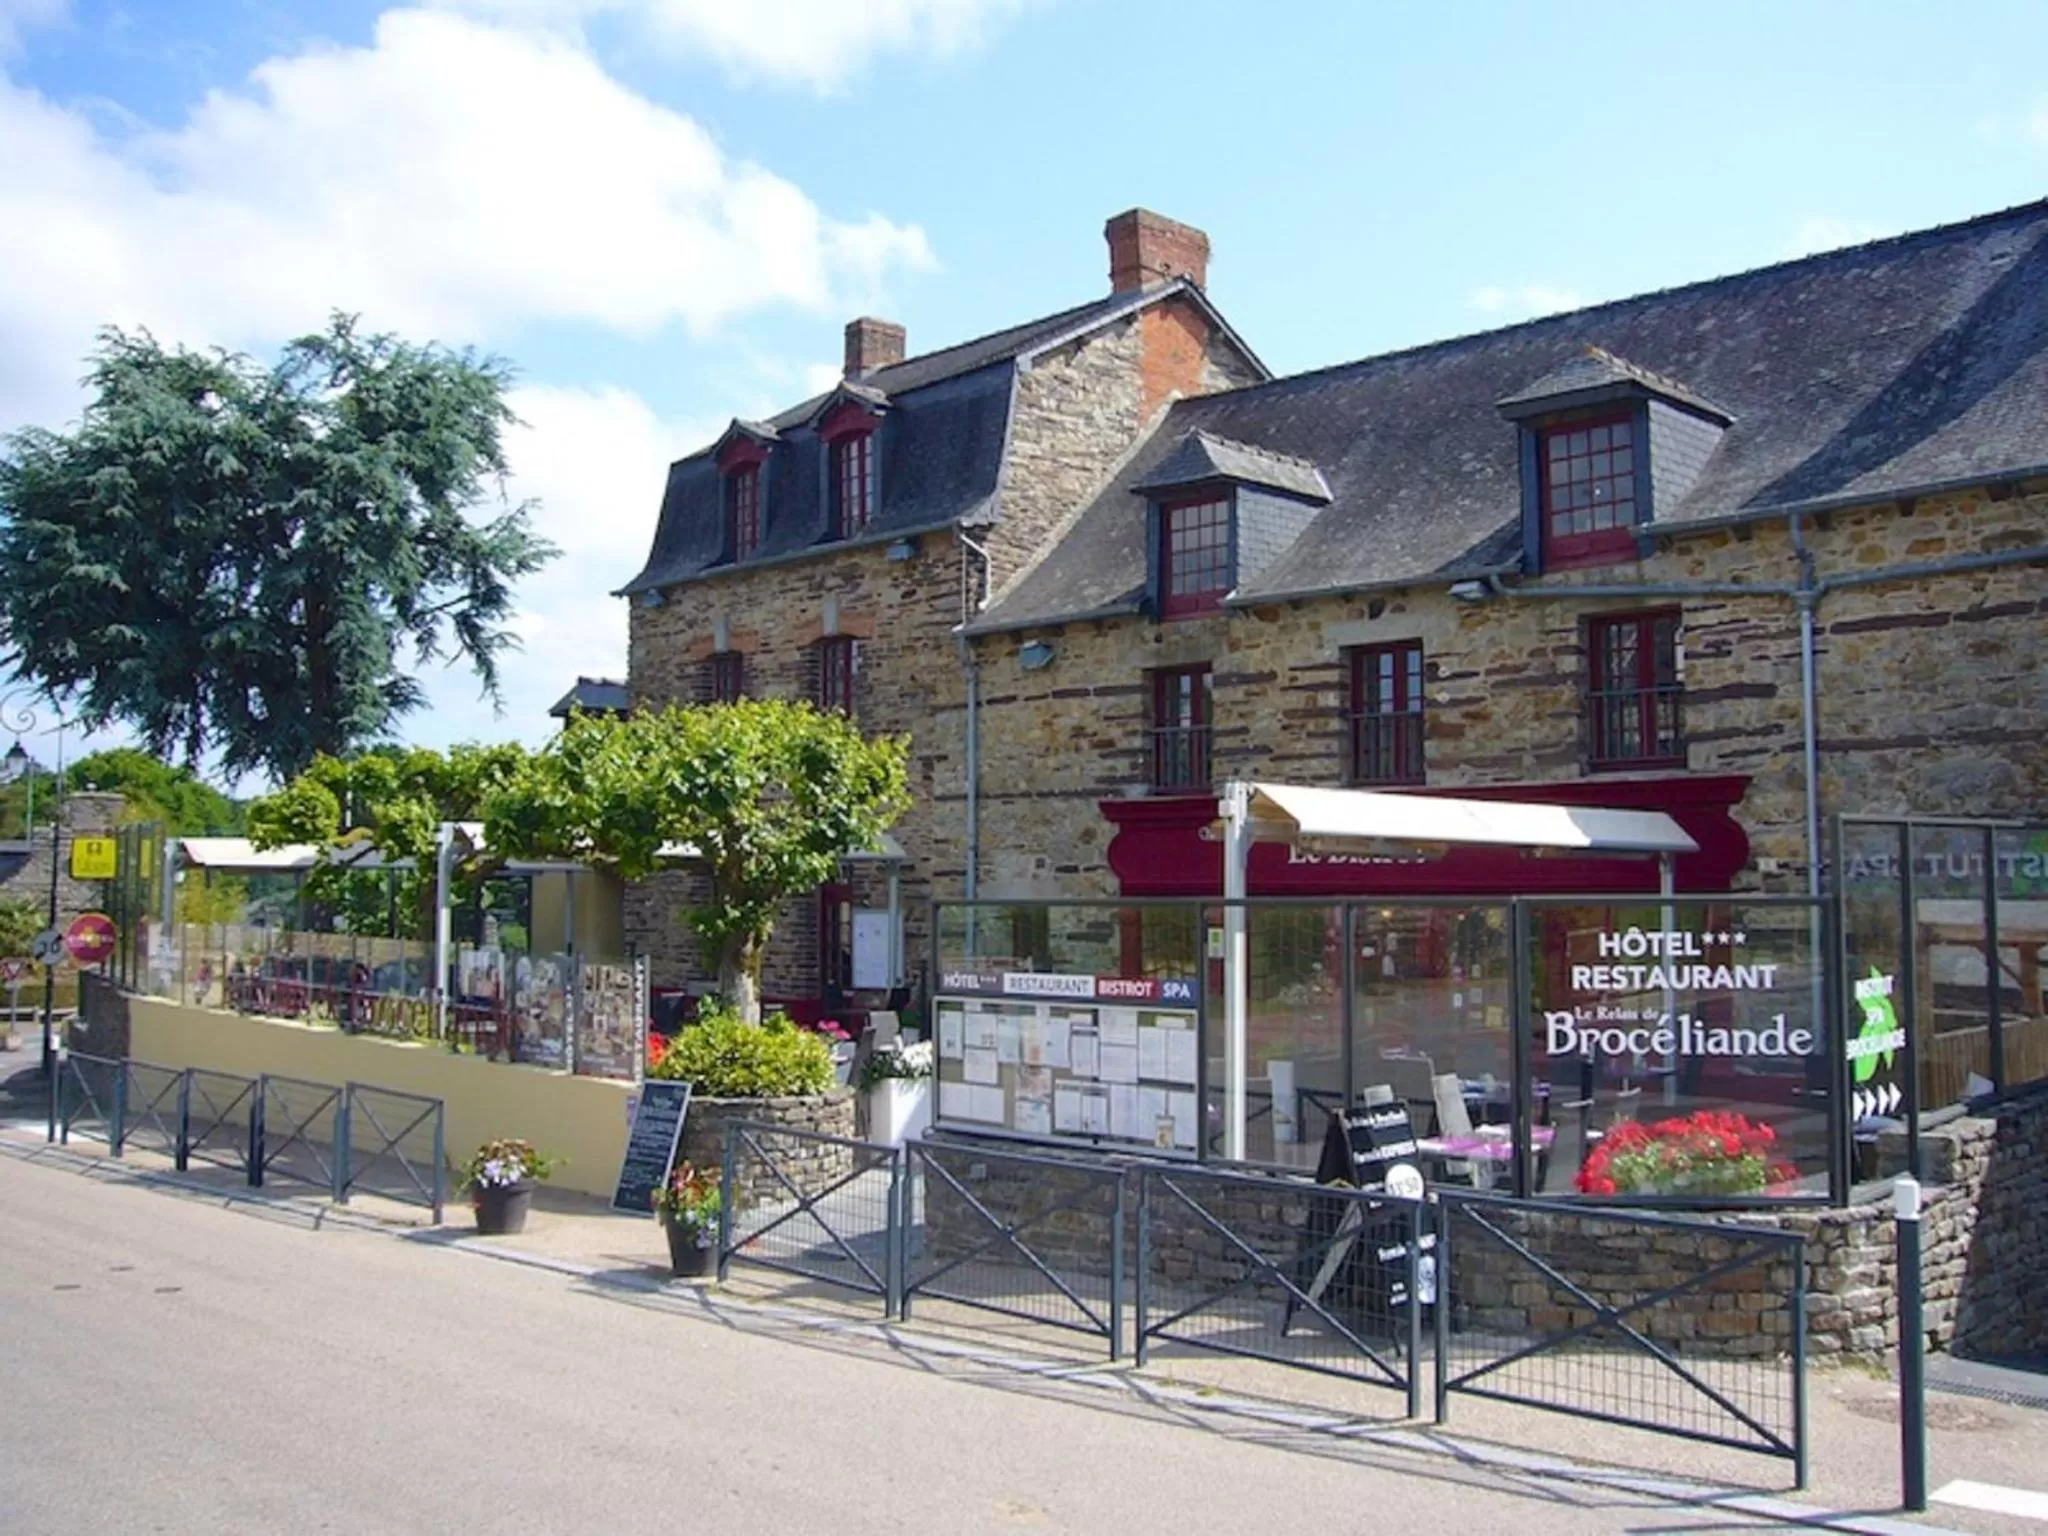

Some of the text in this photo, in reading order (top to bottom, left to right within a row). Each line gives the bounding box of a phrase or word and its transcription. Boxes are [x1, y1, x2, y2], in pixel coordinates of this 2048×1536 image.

[1599, 926, 1702, 957] HÔTEL
[943, 971, 1191, 999] HÔTEL RESTAURANT BISTROT SPA
[1571, 964, 1778, 990] RESTAURANT
[1544, 1009, 1814, 1057] Brocéliande
